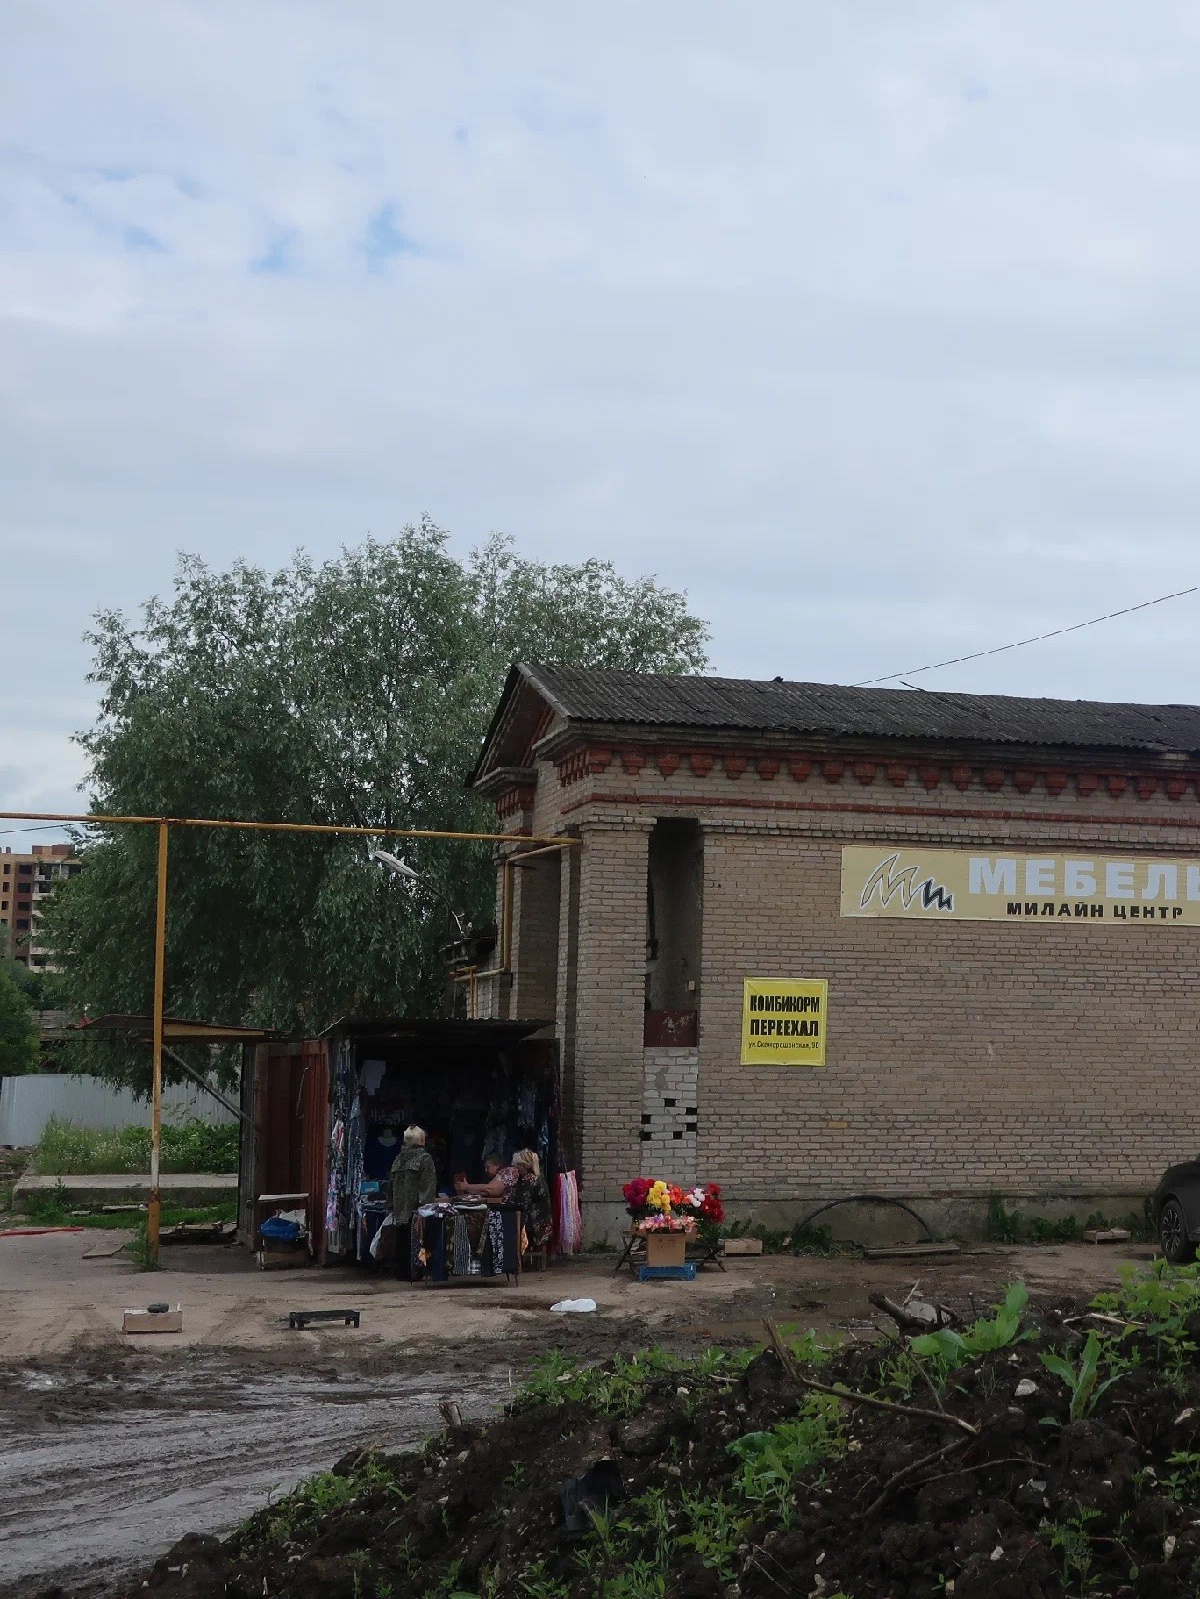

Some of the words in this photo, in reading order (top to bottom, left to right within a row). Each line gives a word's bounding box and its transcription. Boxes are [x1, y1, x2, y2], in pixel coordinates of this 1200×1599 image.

[1006, 901, 1104, 918] МИЛАЙН
[1113, 905, 1184, 920] ЦЕНТР
[750, 994, 819, 1013] КОМБИКОРМ
[750, 1019, 819, 1036] ПЕРЕЕХАЛ
